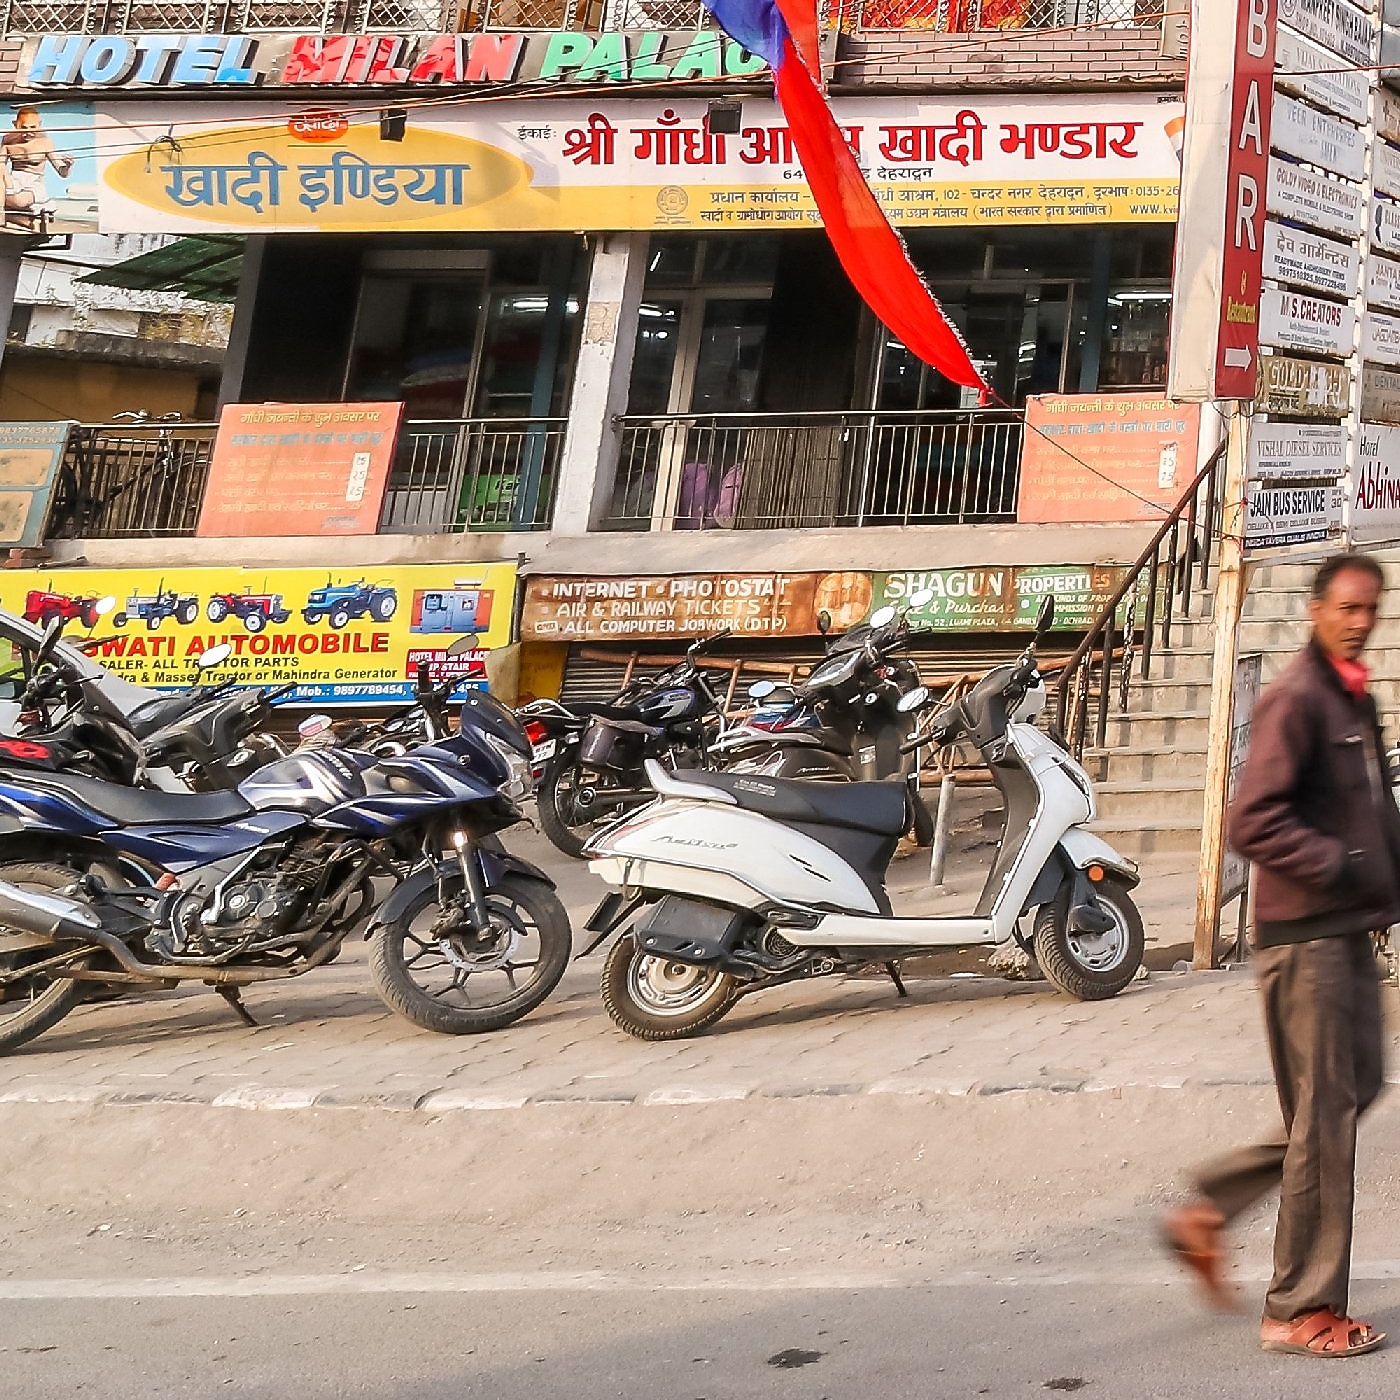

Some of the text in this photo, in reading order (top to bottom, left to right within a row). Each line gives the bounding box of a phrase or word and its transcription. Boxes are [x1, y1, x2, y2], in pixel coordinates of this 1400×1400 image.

[28, 31, 773, 86] HOTEL MILAN PALAC
[564, 111, 618, 166] श्री
[878, 109, 987, 167] खादी
[999, 121, 1144, 160] भण्डार
[161, 151, 470, 214] खादी इण्डिया
[1250, 489, 1326, 518] JAIN BUS SERVICE
[552, 578, 792, 599] INTERNET PHOTOSTAT
[884, 572, 1005, 599] SHAGUN
[557, 598, 761, 617] AIR & RAILWAY TICKETS
[563, 616, 787, 634] ALL COMPUTER JOBWORK (DTP)
[187, 632, 390, 657] AUTOMOBILE
[153, 656, 300, 669] ALL PARTS
[205, 669, 253, 683] Tractor
[272, 667, 331, 681] Mahindra
[334, 666, 399, 680] Generator
